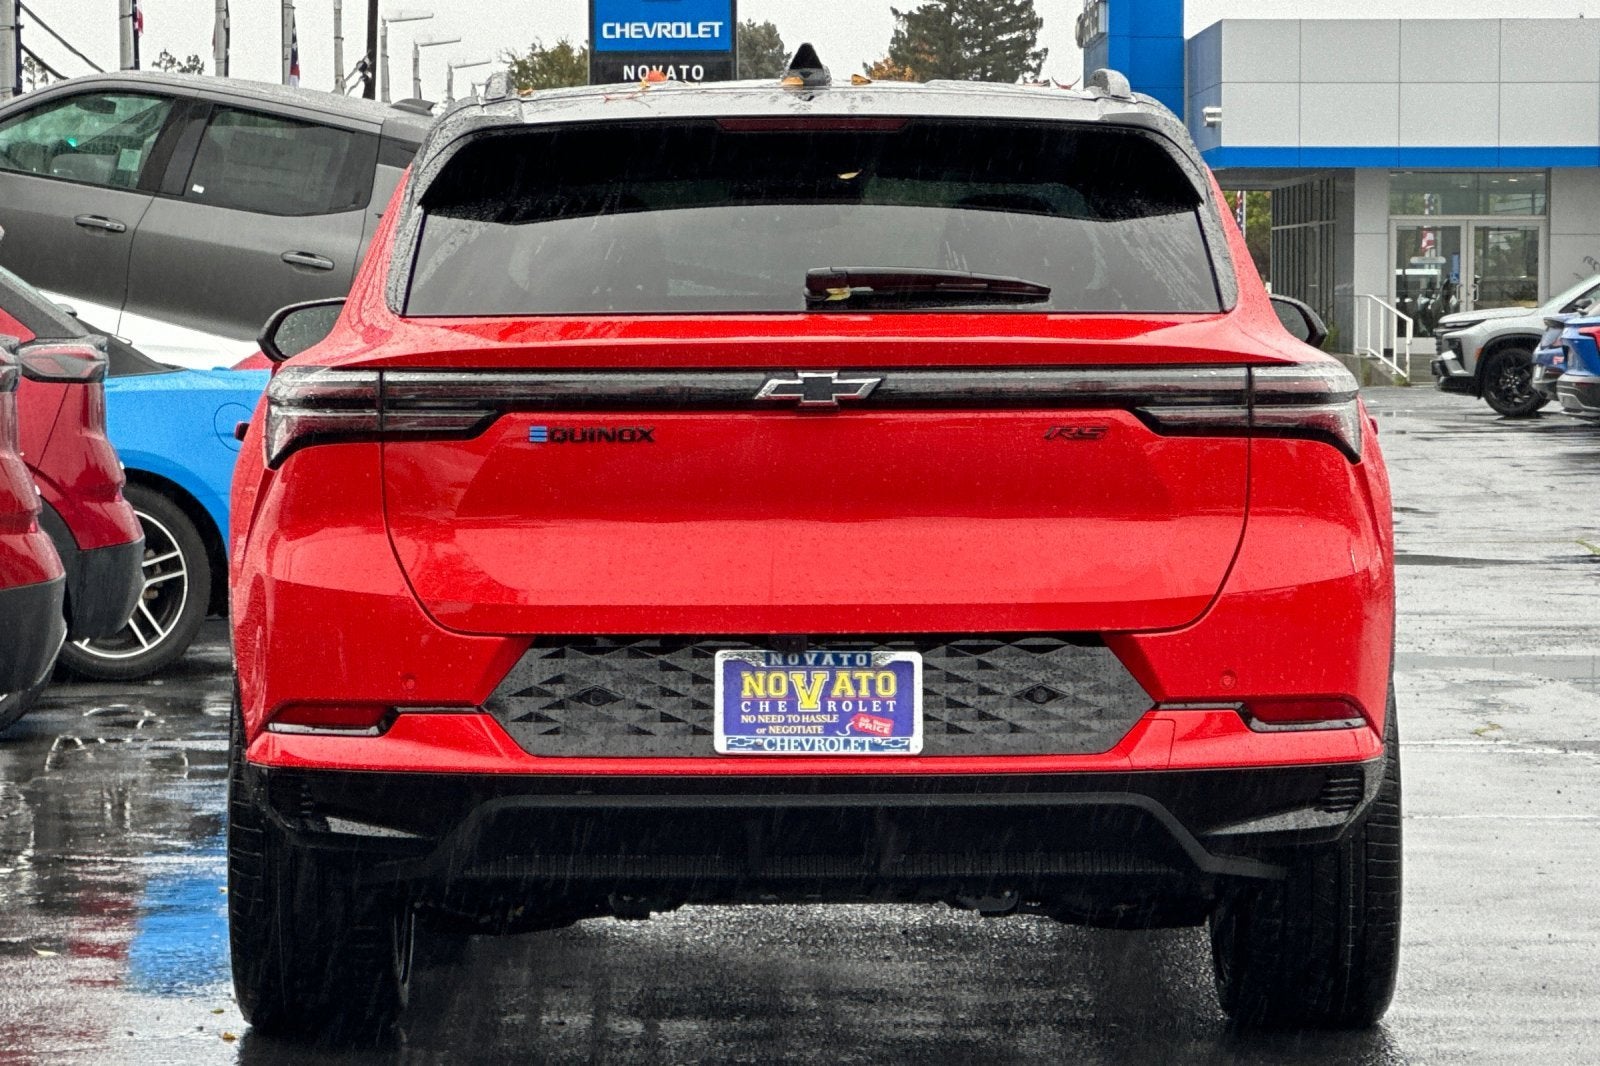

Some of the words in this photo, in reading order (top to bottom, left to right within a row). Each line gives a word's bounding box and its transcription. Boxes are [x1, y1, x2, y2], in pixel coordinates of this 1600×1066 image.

[602, 21, 723, 39] CHEVROLET
[529, 425, 655, 443] EQUINOX
[1043, 426, 1108, 440] RS
[769, 653, 867, 666] NOVATO
[741, 671, 897, 712] NOVATO
[741, 714, 756, 723] NO
[758, 714, 785, 723] NEED
[786, 714, 800, 723] TO
[802, 714, 839, 723] HASSLE
[768, 725, 824, 734] NEGOTIATE
[858, 722, 890, 734] PRICE
[763, 737, 872, 751] CHEVROLET
